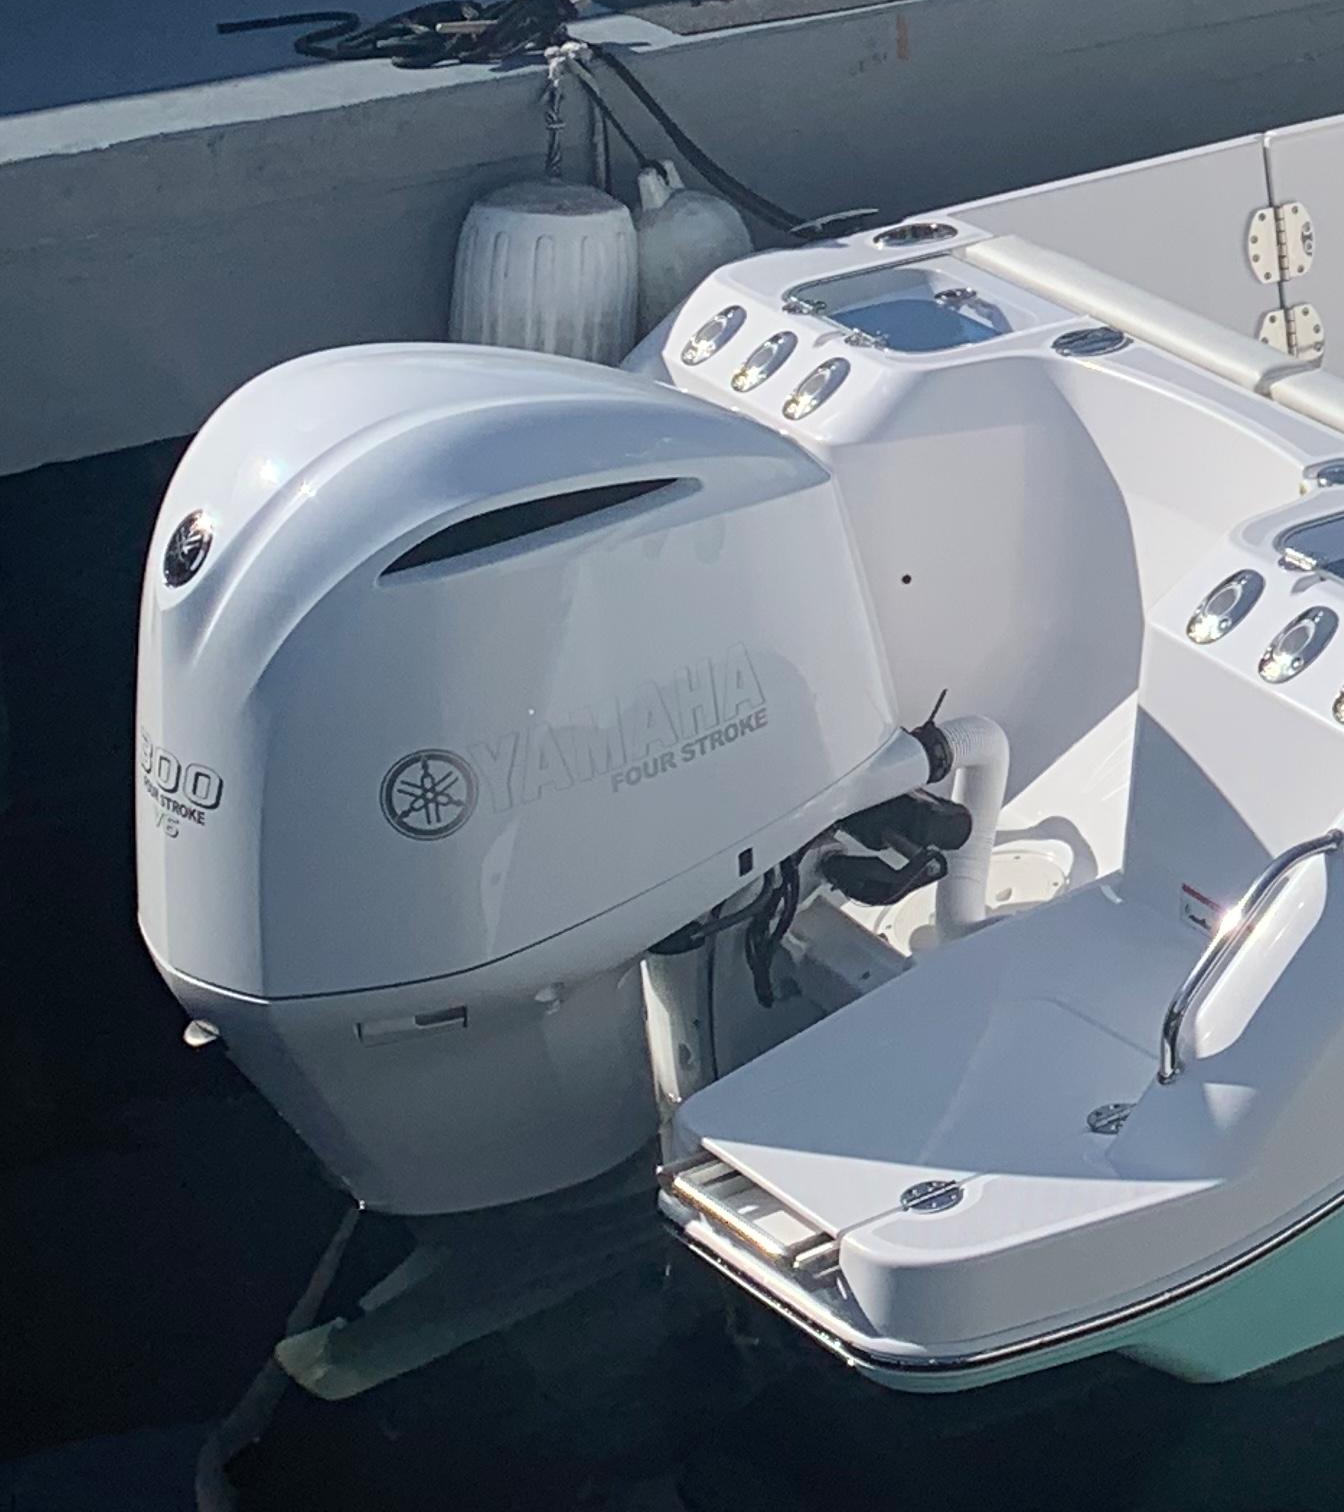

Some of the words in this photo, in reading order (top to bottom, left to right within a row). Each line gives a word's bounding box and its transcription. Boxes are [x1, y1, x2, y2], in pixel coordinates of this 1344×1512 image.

[468, 640, 766, 815] YAMAHA
[611, 751, 677, 792] FOUR
[680, 707, 769, 763] STROKE
[160, 793, 206, 827] STROKE
